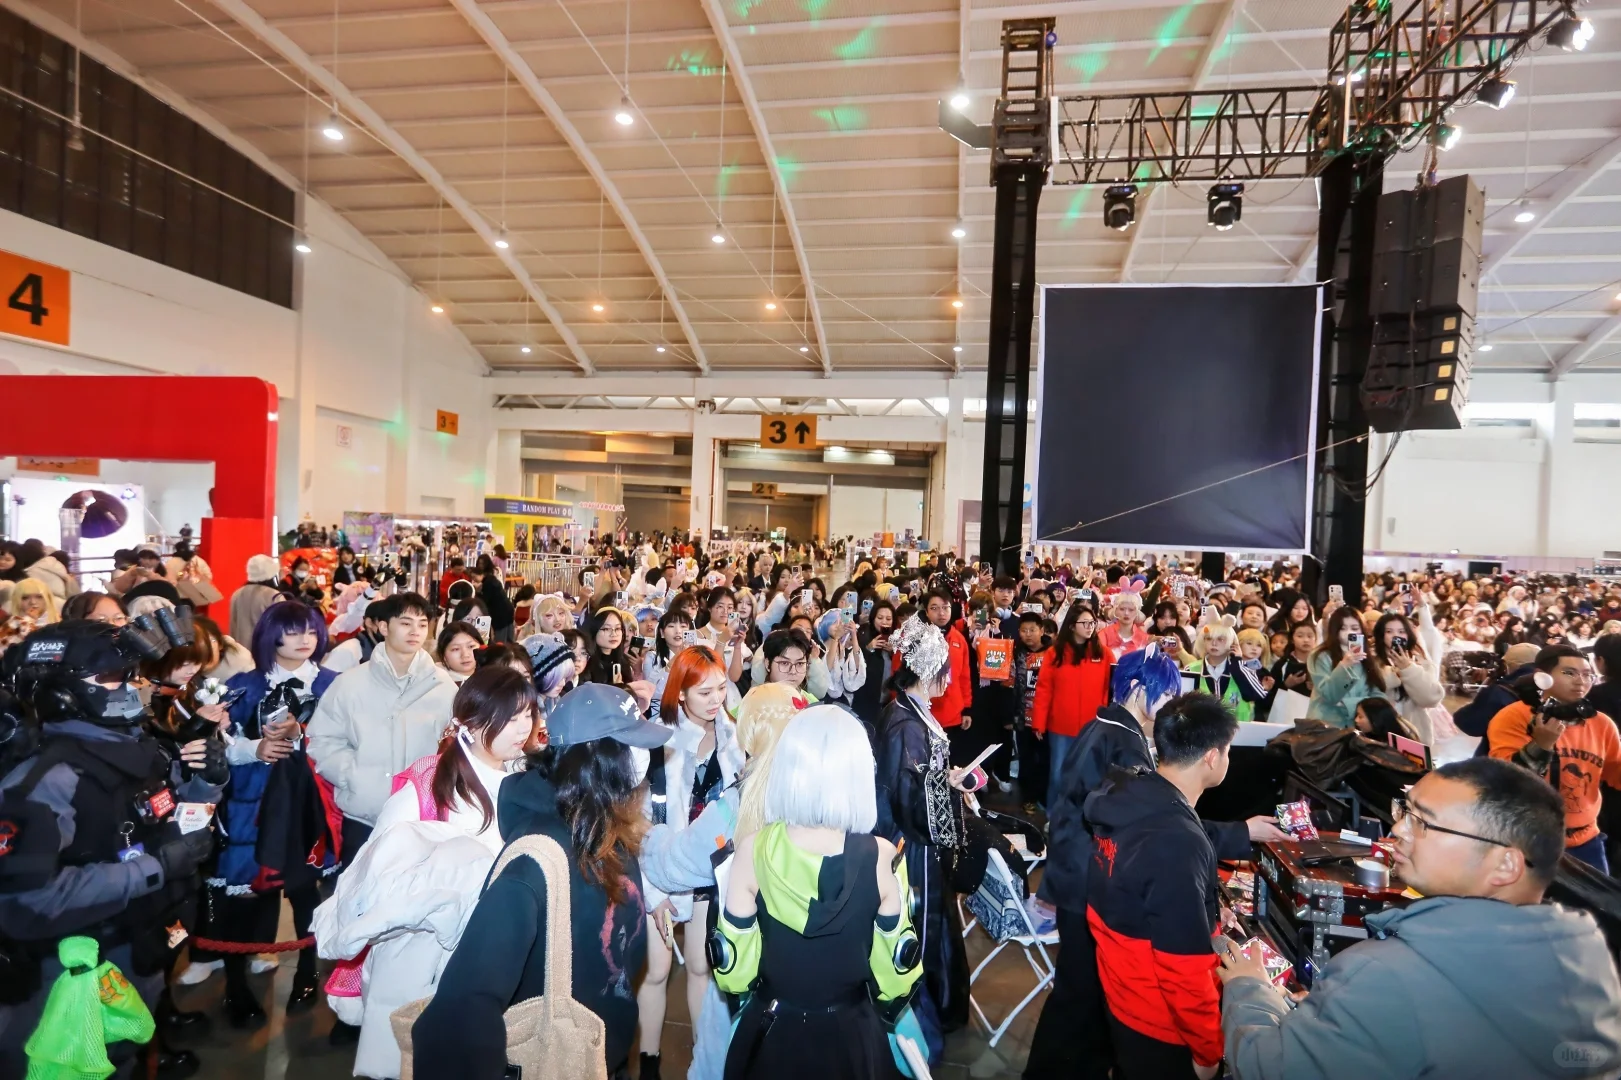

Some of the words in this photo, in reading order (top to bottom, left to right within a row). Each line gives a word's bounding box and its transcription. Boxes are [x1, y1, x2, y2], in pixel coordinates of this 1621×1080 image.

[8, 272, 49, 326] 4
[440, 415, 447, 428] 3
[769, 420, 787, 444] 3
[755, 483, 764, 494] 2
[522, 504, 547, 513] RANDOM
[547, 506, 561, 515] PLAY
[1554, 746, 1604, 769] ANUTS
